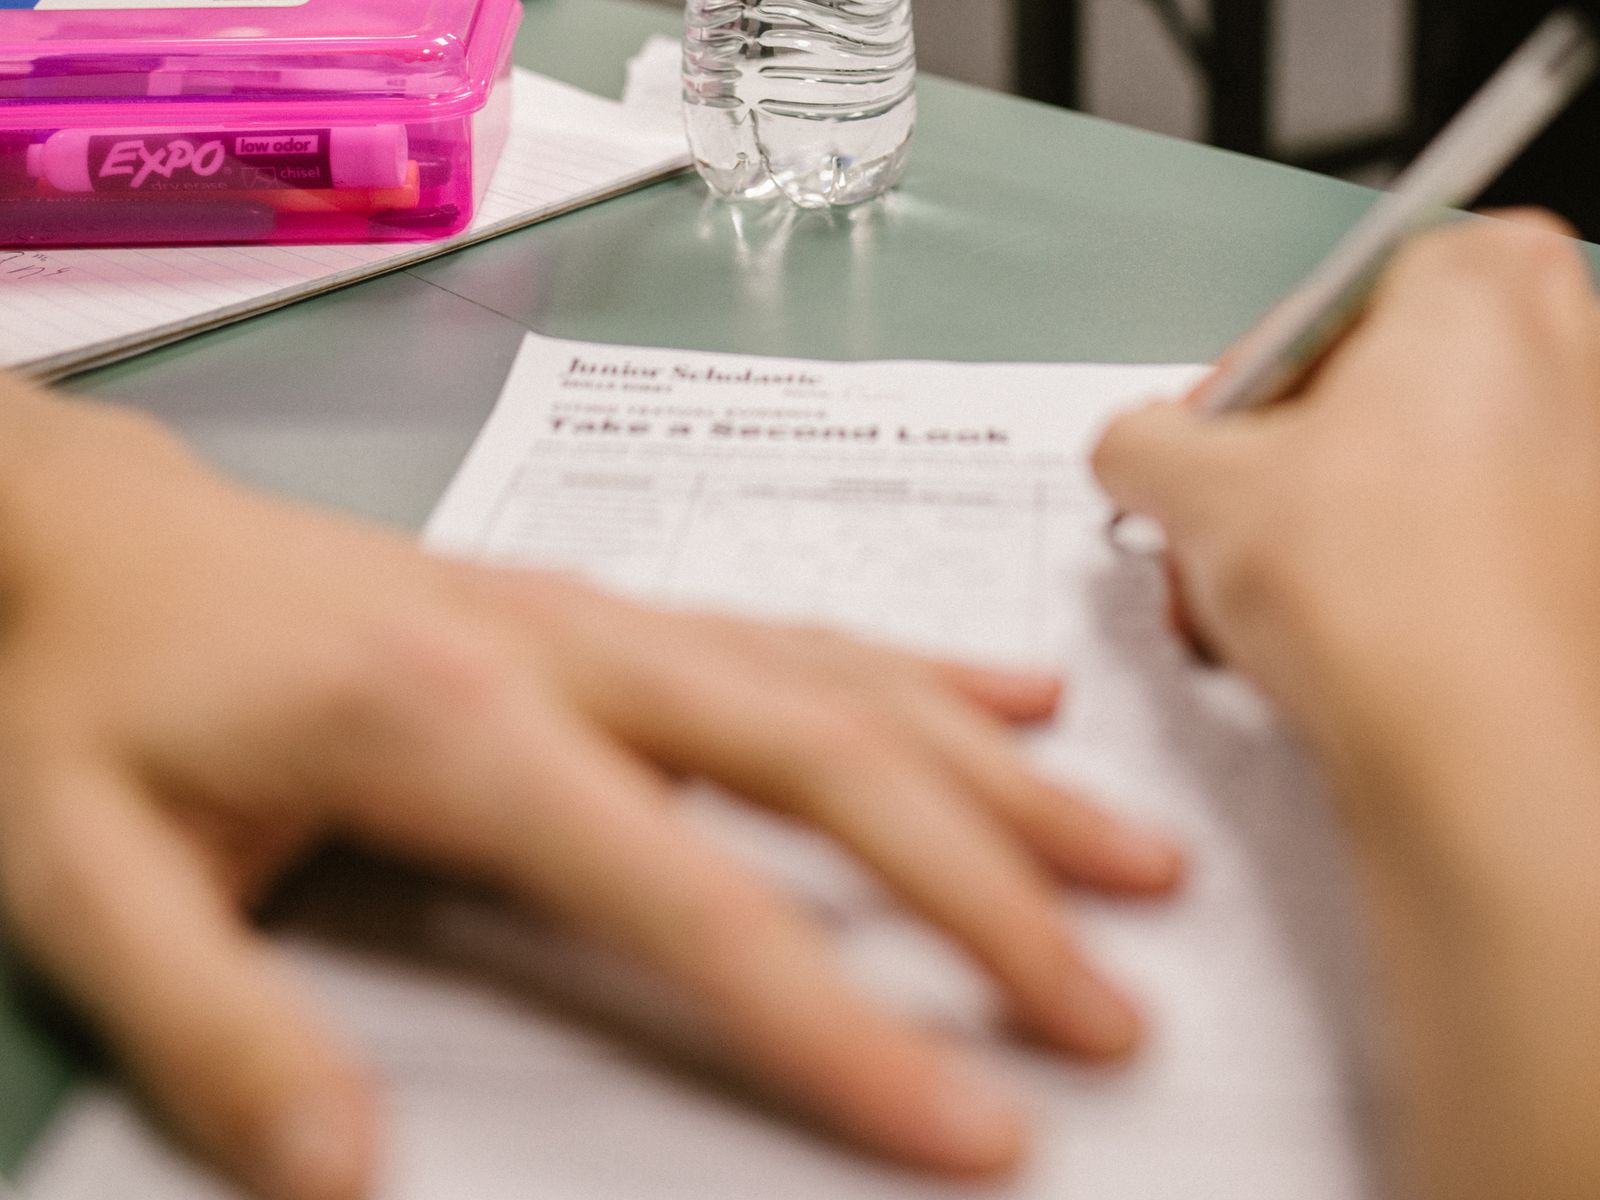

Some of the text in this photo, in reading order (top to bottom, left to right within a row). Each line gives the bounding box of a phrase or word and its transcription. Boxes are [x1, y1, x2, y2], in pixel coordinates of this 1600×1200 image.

[241, 138, 311, 153] low odor
[99, 139, 226, 188] EXPO
[280, 166, 321, 179] chisel
[569, 357, 659, 377] Junior
[673, 364, 821, 386] Scholastic
[550, 415, 1010, 445] Take a Second Look
